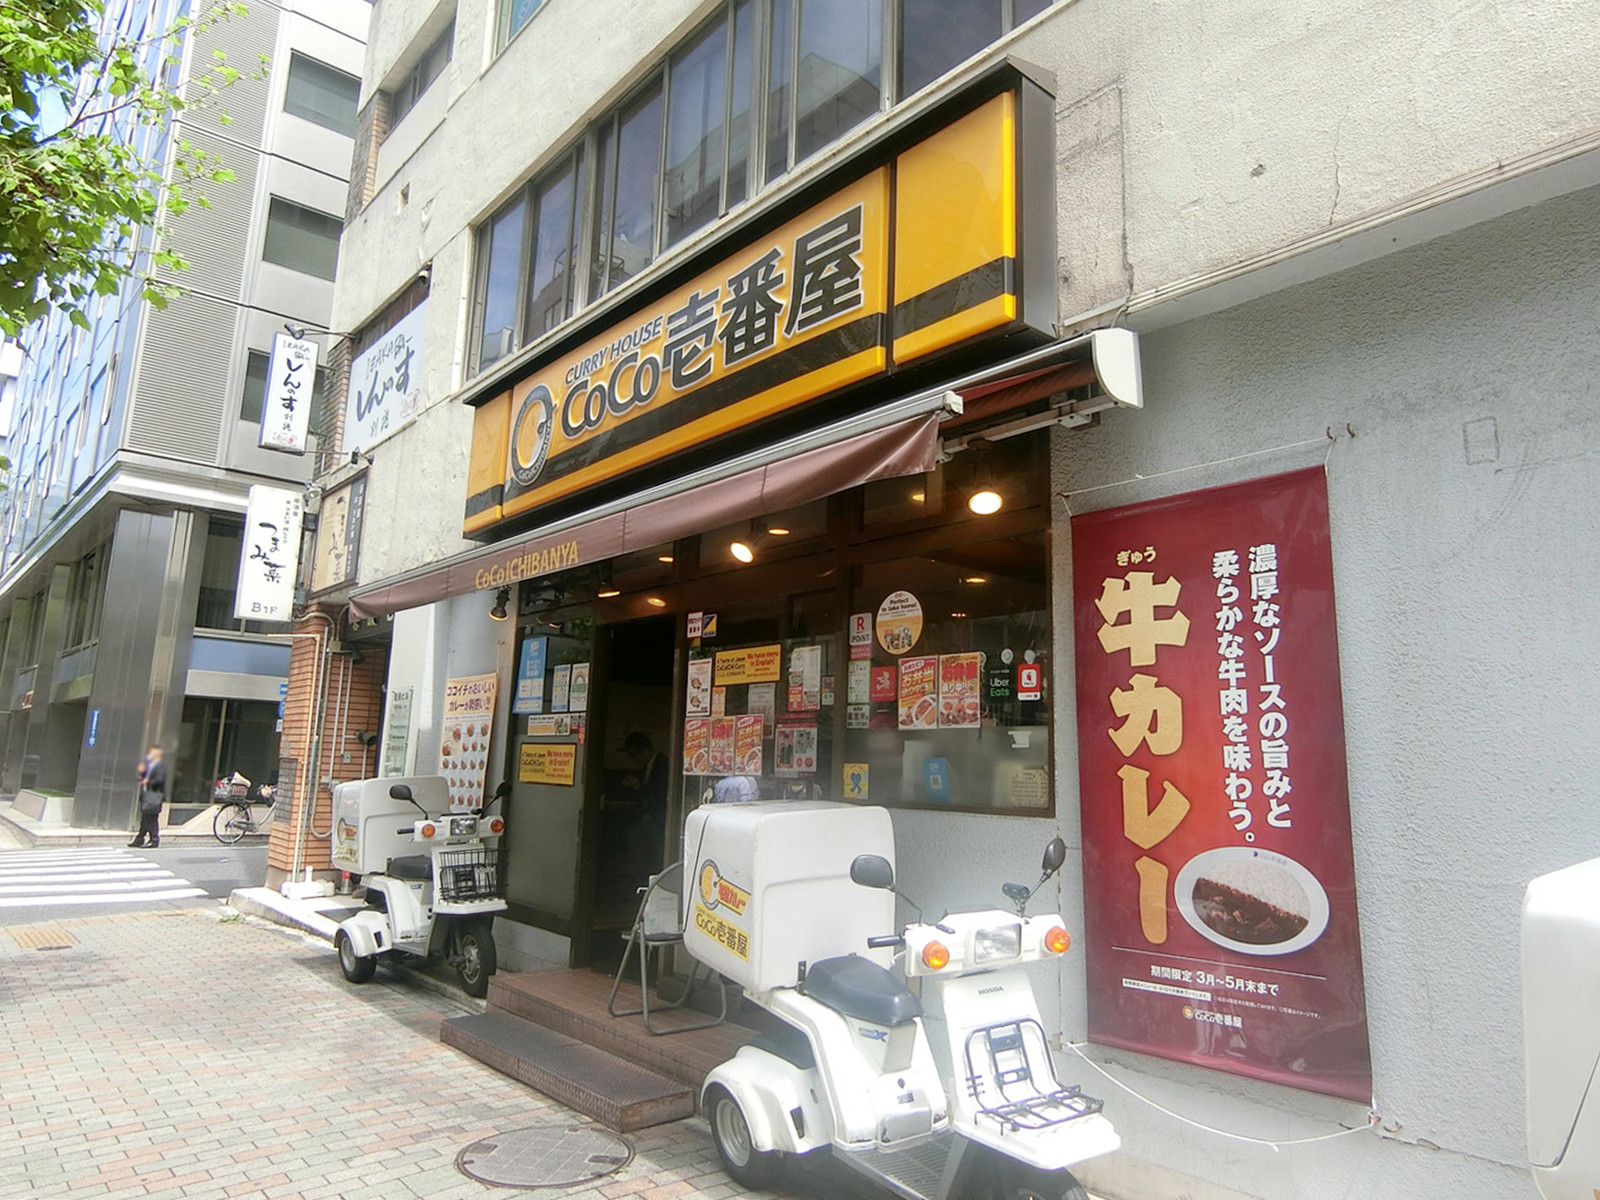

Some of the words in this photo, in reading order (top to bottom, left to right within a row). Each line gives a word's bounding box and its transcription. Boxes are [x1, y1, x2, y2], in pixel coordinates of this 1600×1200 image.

[561, 202, 864, 439] CoCo壱番屋
[565, 346, 609, 385] CURRY
[609, 314, 664, 362] HOUSE
[505, 541, 579, 580] ICHIBANYA
[1116, 546, 1157, 567] ぎゅう
[251, 602, 278, 615] B1F
[851, 634, 870, 643] POINT
[989, 677, 1010, 687] Uber
[989, 688, 1010, 697] Eats
[1212, 549, 1256, 842] 柔らかな牛肉を味わう。
[1248, 543, 1292, 829] 濃厚なソースの旨みと
[1094, 571, 1192, 945] 牛カレー
[695, 912, 749, 958] CoCo壱番屋
[1150, 964, 1193, 983] 期間限定
[977, 985, 1005, 996] HONDA
